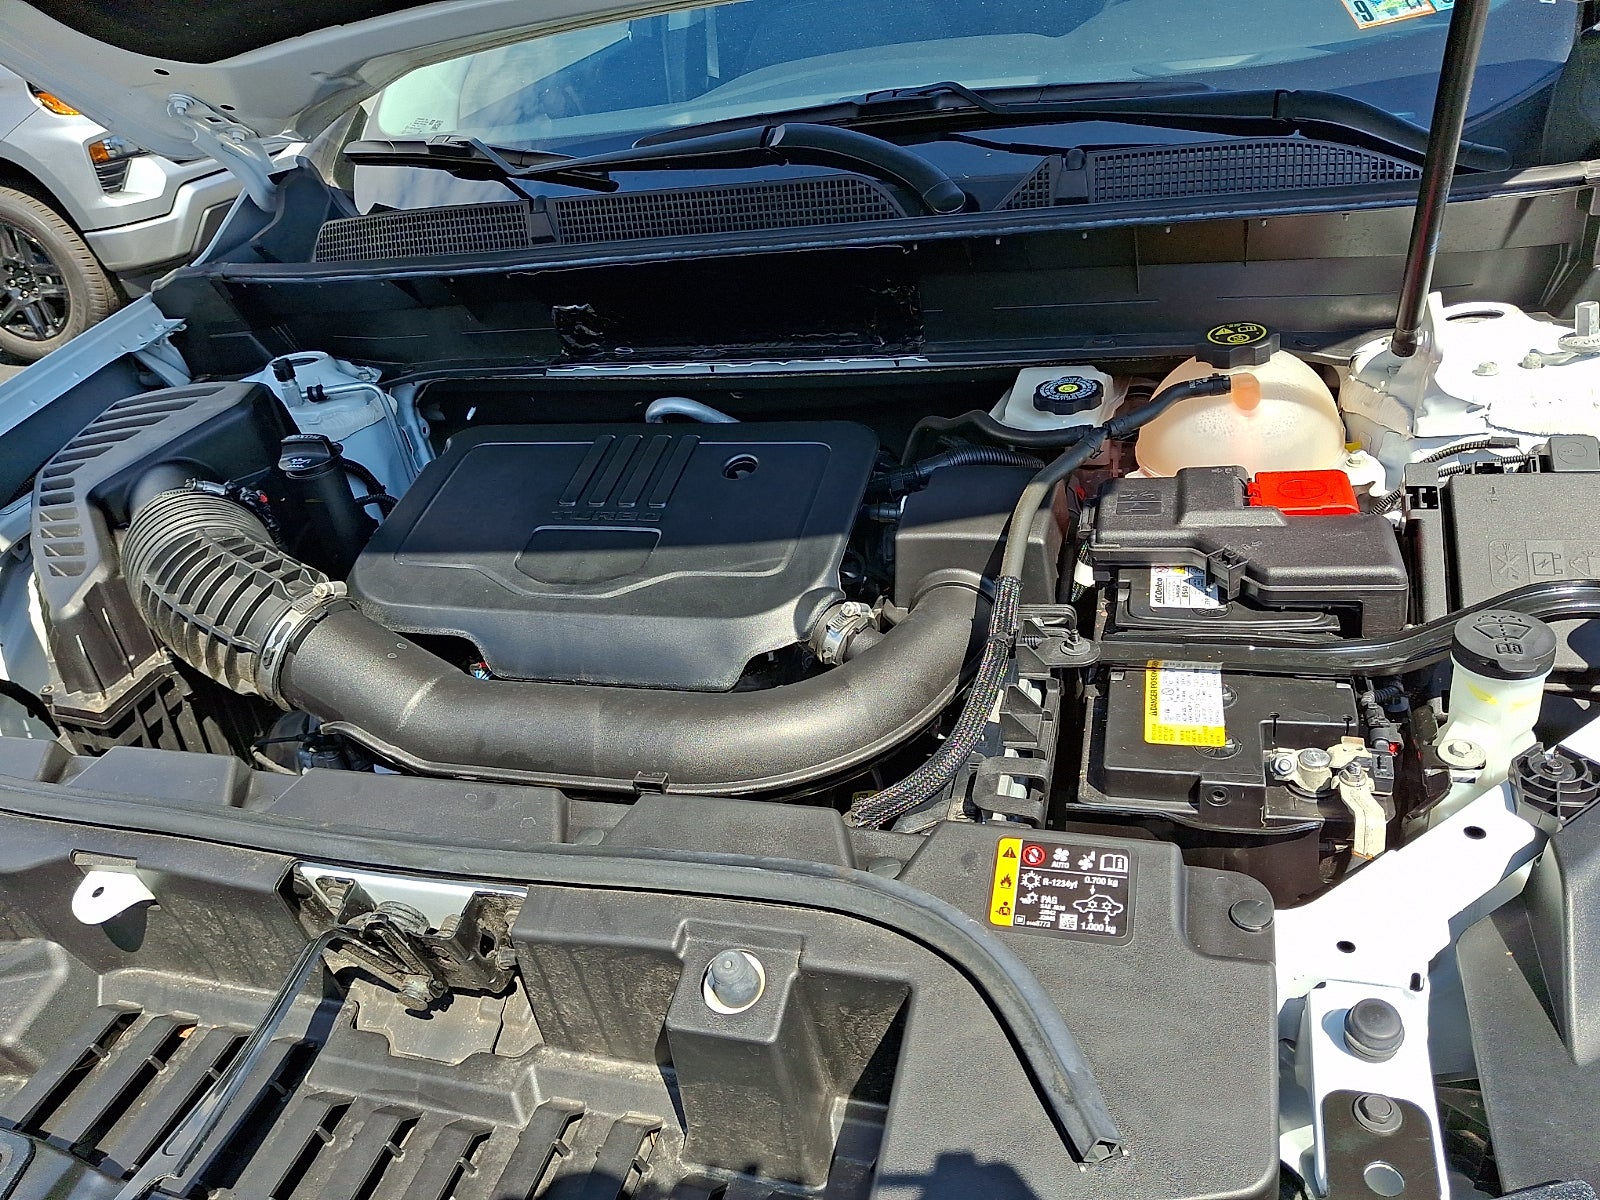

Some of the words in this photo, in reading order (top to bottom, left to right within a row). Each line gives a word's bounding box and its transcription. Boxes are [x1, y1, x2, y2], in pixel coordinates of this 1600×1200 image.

[1354, 1, 1375, 22] 9
[552, 510, 662, 522] TURBO
[1150, 690, 1158, 711] DANGER
[1050, 860, 1070, 869] AUTO
[1042, 879, 1079, 890] R-1234yf
[1084, 876, 1106, 885] 0.700
[1107, 877, 1119, 888] kg
[1040, 894, 1058, 905] PAG
[1080, 921, 1105, 932] 1.000
[1105, 924, 1117, 935] kg
